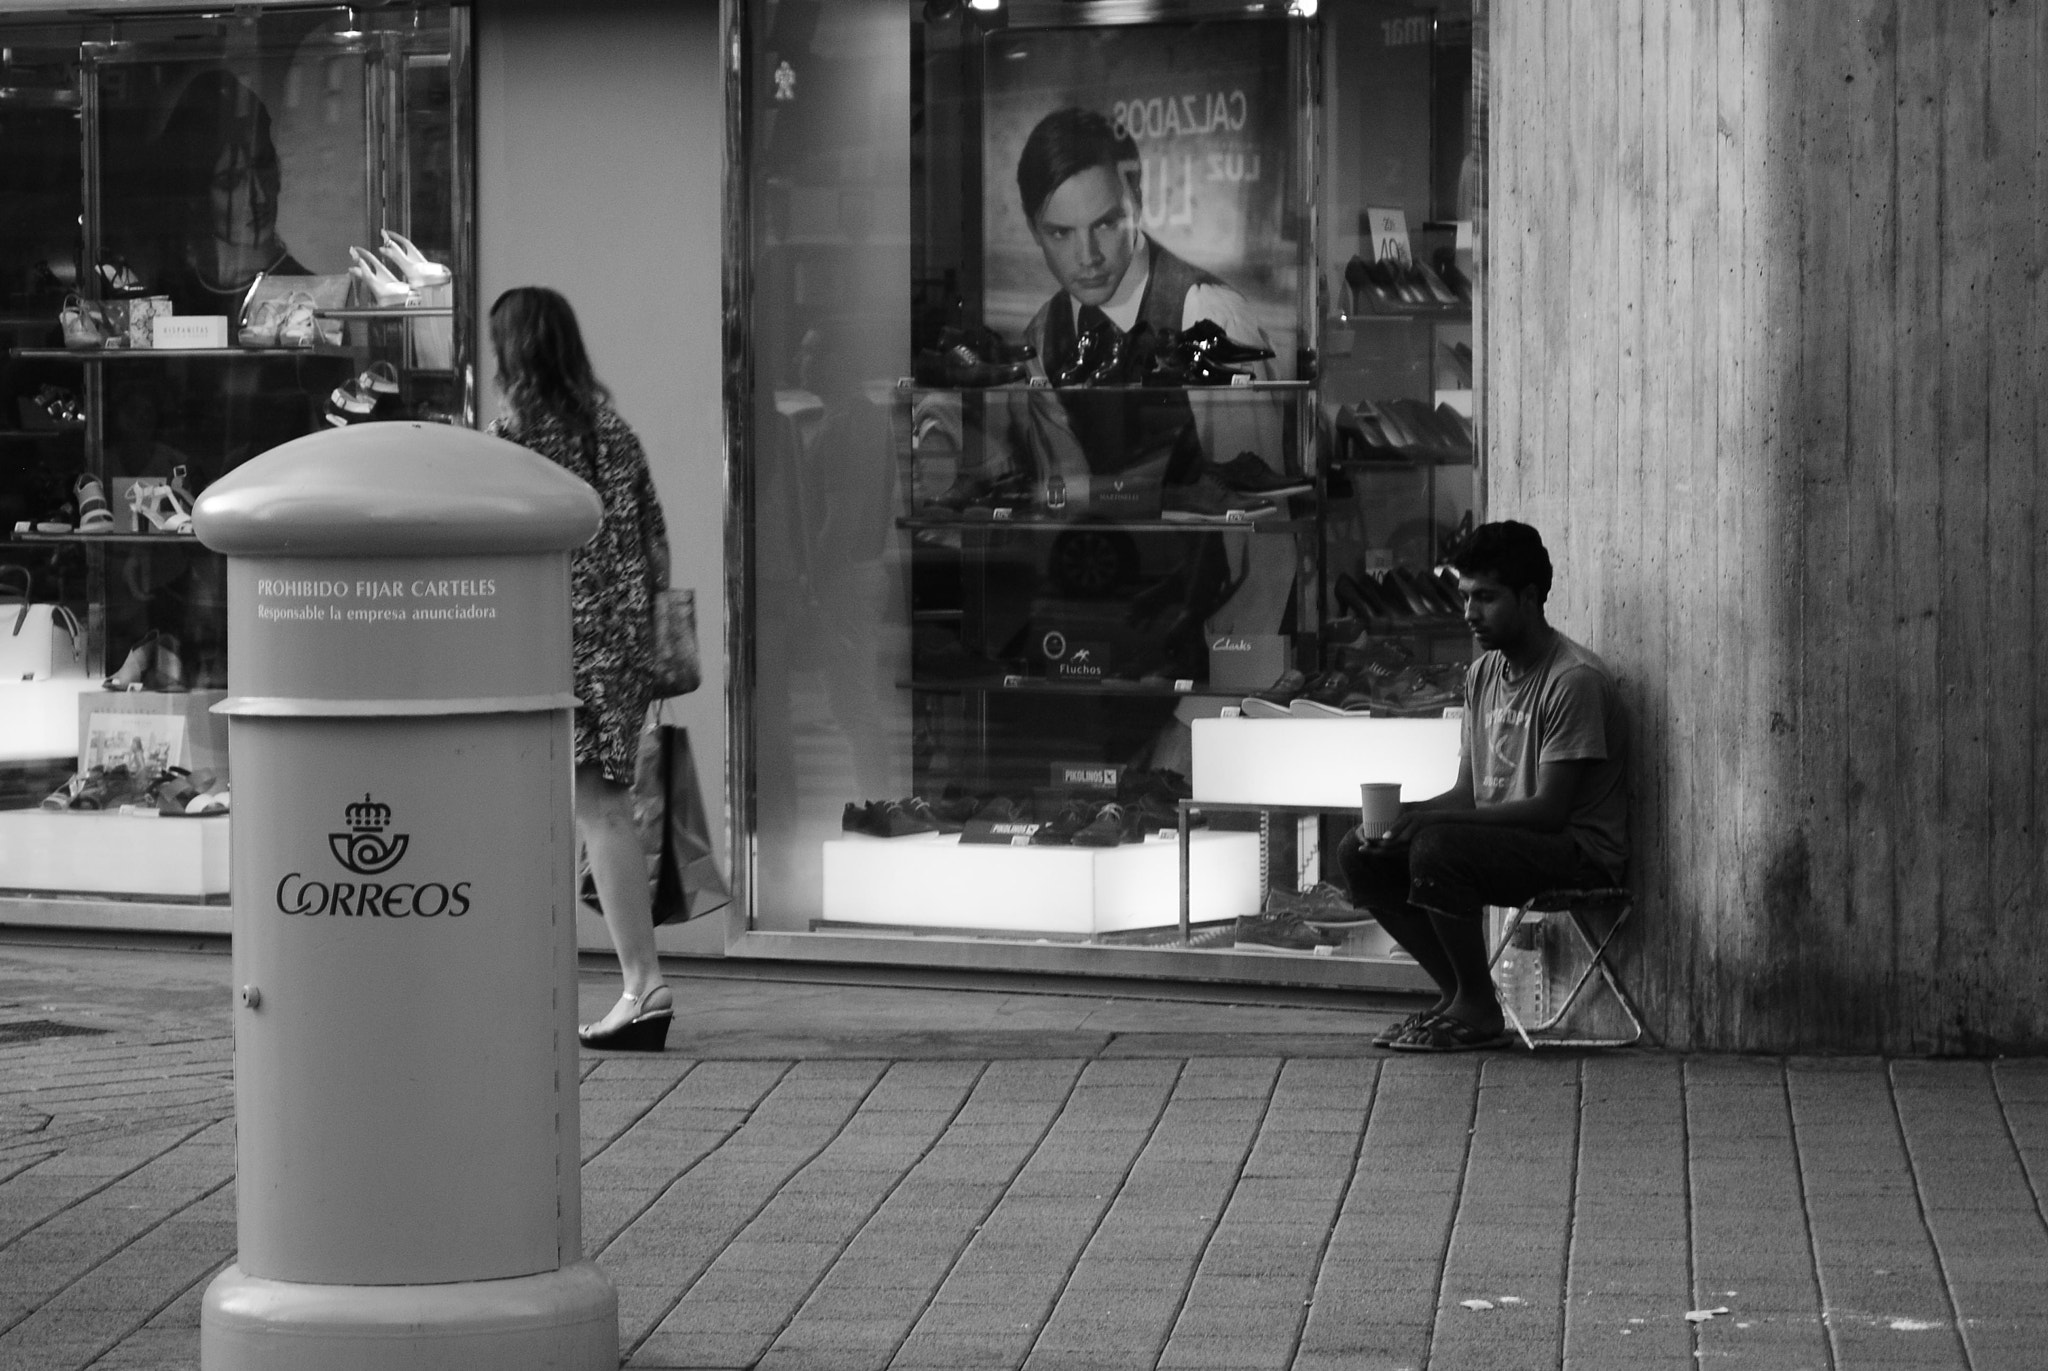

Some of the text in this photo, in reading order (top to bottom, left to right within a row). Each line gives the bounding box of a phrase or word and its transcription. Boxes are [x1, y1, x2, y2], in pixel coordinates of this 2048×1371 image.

[258, 579, 496, 600] PROHIBIDO FIJAR CARTELES
[258, 604, 496, 623] Responsable la empresa anunciadora
[1212, 637, 1252, 651] Clarks
[1059, 663, 1102, 675] Fluchos
[1064, 769, 1104, 783] PIKOLINOS
